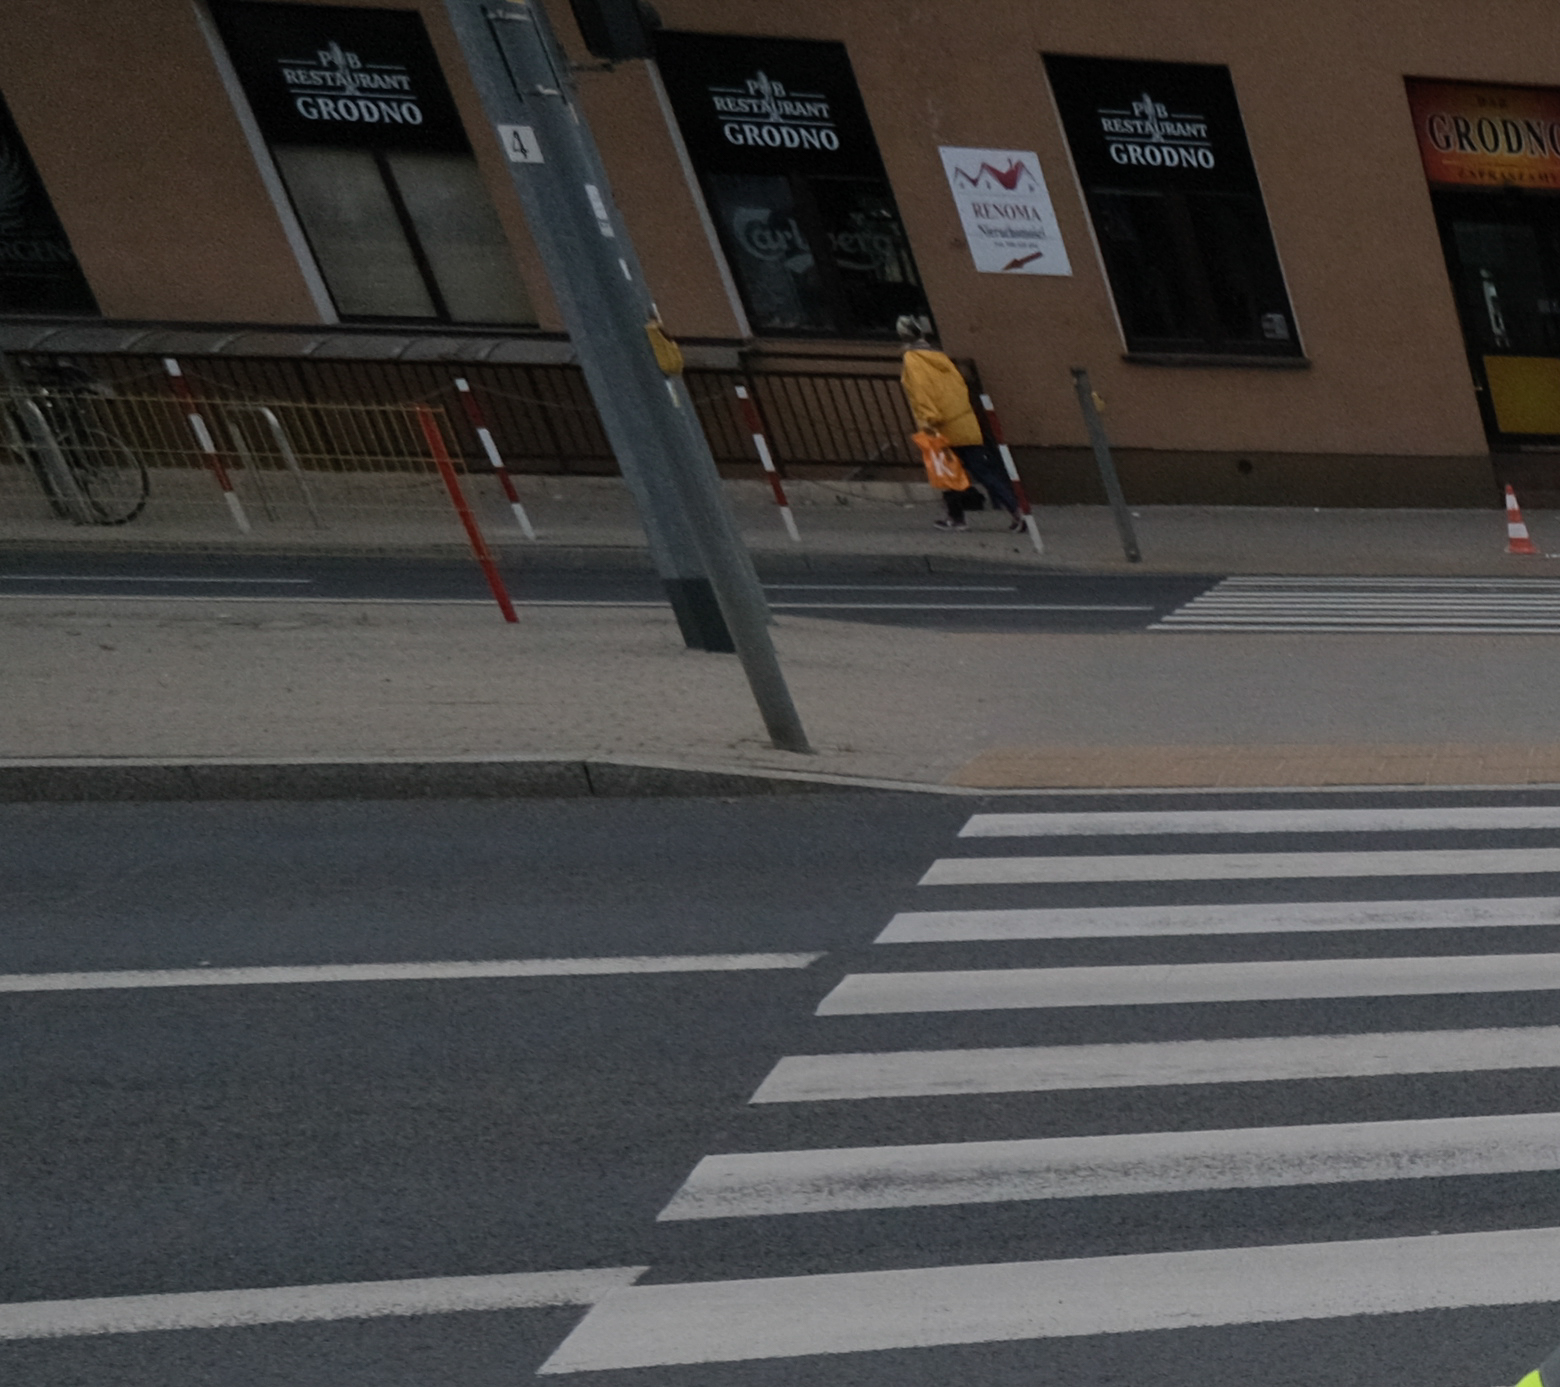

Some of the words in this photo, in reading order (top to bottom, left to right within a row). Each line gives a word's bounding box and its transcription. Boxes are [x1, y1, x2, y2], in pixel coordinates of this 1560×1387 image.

[284, 67, 412, 92] RESTAURANT
[296, 98, 425, 126] GRODNO
[712, 96, 831, 119] RESTAURANT
[723, 123, 841, 151] GRODNO
[1100, 117, 1208, 138] RESTAURANT
[1109, 143, 1216, 169] GRODNO
[974, 203, 1042, 223] RENOMA
